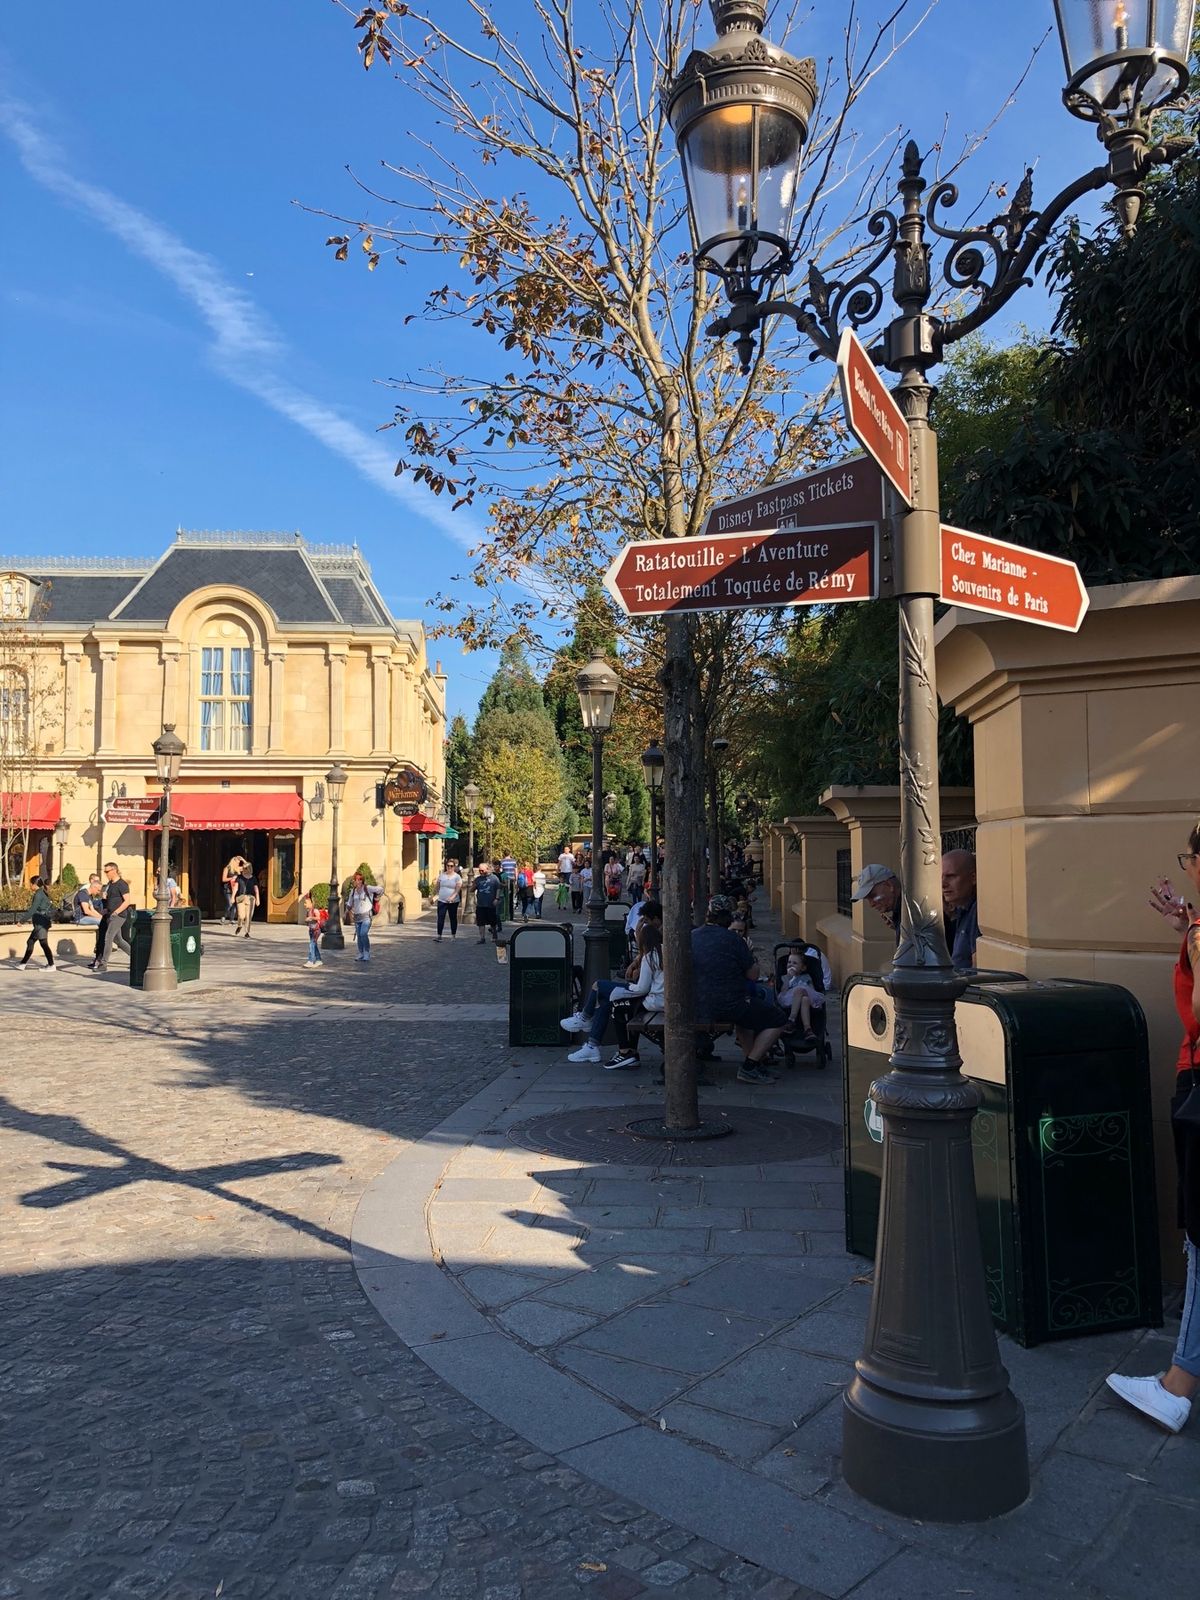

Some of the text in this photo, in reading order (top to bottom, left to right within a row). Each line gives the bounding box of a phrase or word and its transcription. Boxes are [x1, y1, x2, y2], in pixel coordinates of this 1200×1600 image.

[718, 473, 854, 531] Disney Fastpass Tickets
[635, 546, 724, 572] Ratatouille
[951, 541, 976, 566] Chez
[981, 551, 1028, 579] Marianne
[635, 569, 856, 602] Totalement Toquée de Rémy
[951, 574, 1049, 614] Souvenirs de Paris
